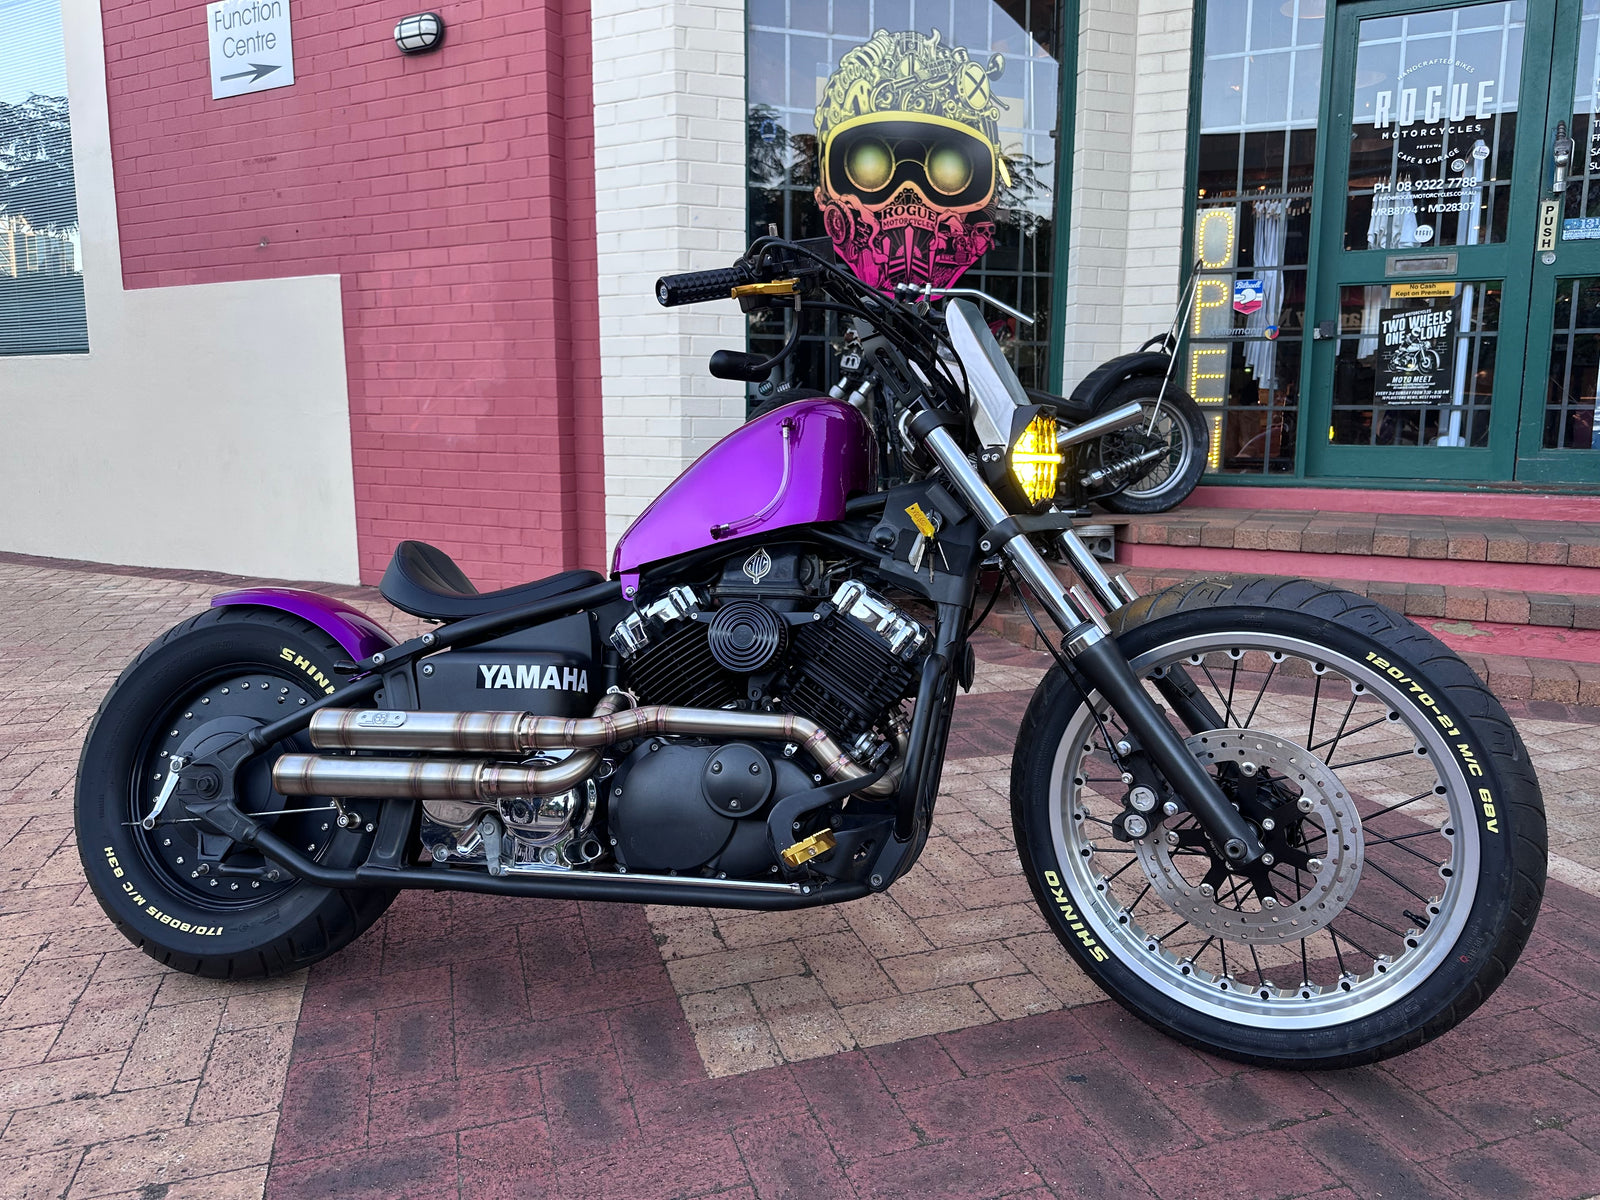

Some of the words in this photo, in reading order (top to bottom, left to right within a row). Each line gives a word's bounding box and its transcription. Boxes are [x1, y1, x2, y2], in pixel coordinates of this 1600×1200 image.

[215, 1, 281, 32] Function
[223, 31, 276, 58] Centre
[1397, 58, 1453, 80] HANDCRAFTED
[1455, 59, 1475, 74] BIKES
[1374, 80, 1495, 129] ROGUE
[1382, 124, 1482, 140] MOTORCYCLES
[1397, 151, 1415, 164] CAFE
[1425, 147, 1460, 165] GARAGE
[1373, 182, 1391, 194] PH
[1396, 181, 1412, 192] 08
[1414, 179, 1444, 191] 9322
[1447, 177, 1477, 188] 7788
[883, 204, 936, 222] ROGUE
[1428, 202, 1475, 213] MD28307
[883, 217, 936, 230] MOTORCYCLES
[1541, 205, 1555, 248] PUSH
[1382, 318, 1406, 334] TWO
[1409, 310, 1452, 330] WHEELS
[1385, 331, 1405, 346] ONE
[1420, 324, 1447, 341] LOVE
[1413, 375, 1432, 383] MEET
[479, 664, 588, 693] YAMAHA
[1364, 651, 1461, 737] 120/70-21
[1457, 743, 1483, 777] M/C
[1478, 788, 1499, 834] 68V
[122, 881, 146, 906] M/C
[1044, 870, 1109, 962] SHINKO
